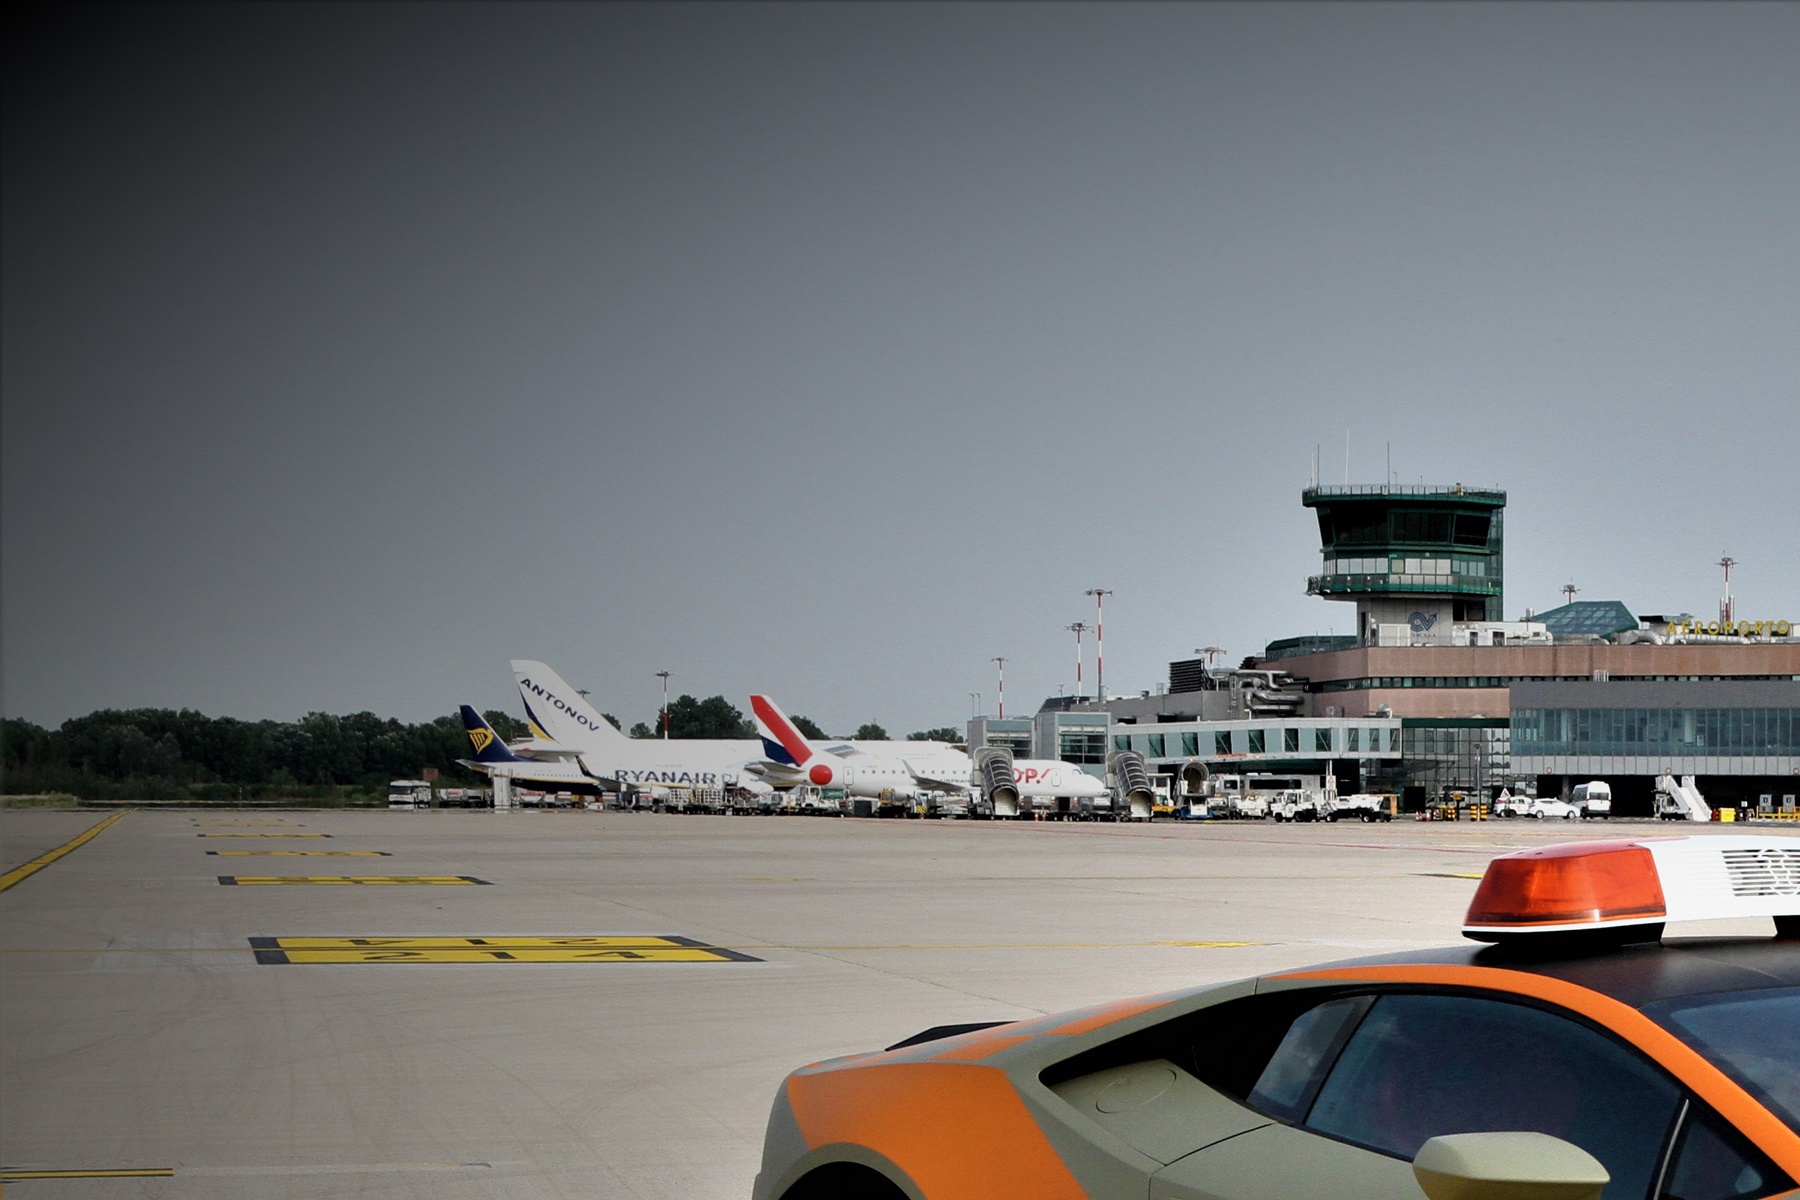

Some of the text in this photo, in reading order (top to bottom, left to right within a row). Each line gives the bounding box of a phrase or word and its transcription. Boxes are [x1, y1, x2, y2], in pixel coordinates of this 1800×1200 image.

[1667, 619, 1790, 636] AEROPORTO
[520, 678, 600, 732] ANTONOV
[614, 769, 717, 785] RYANAIR
